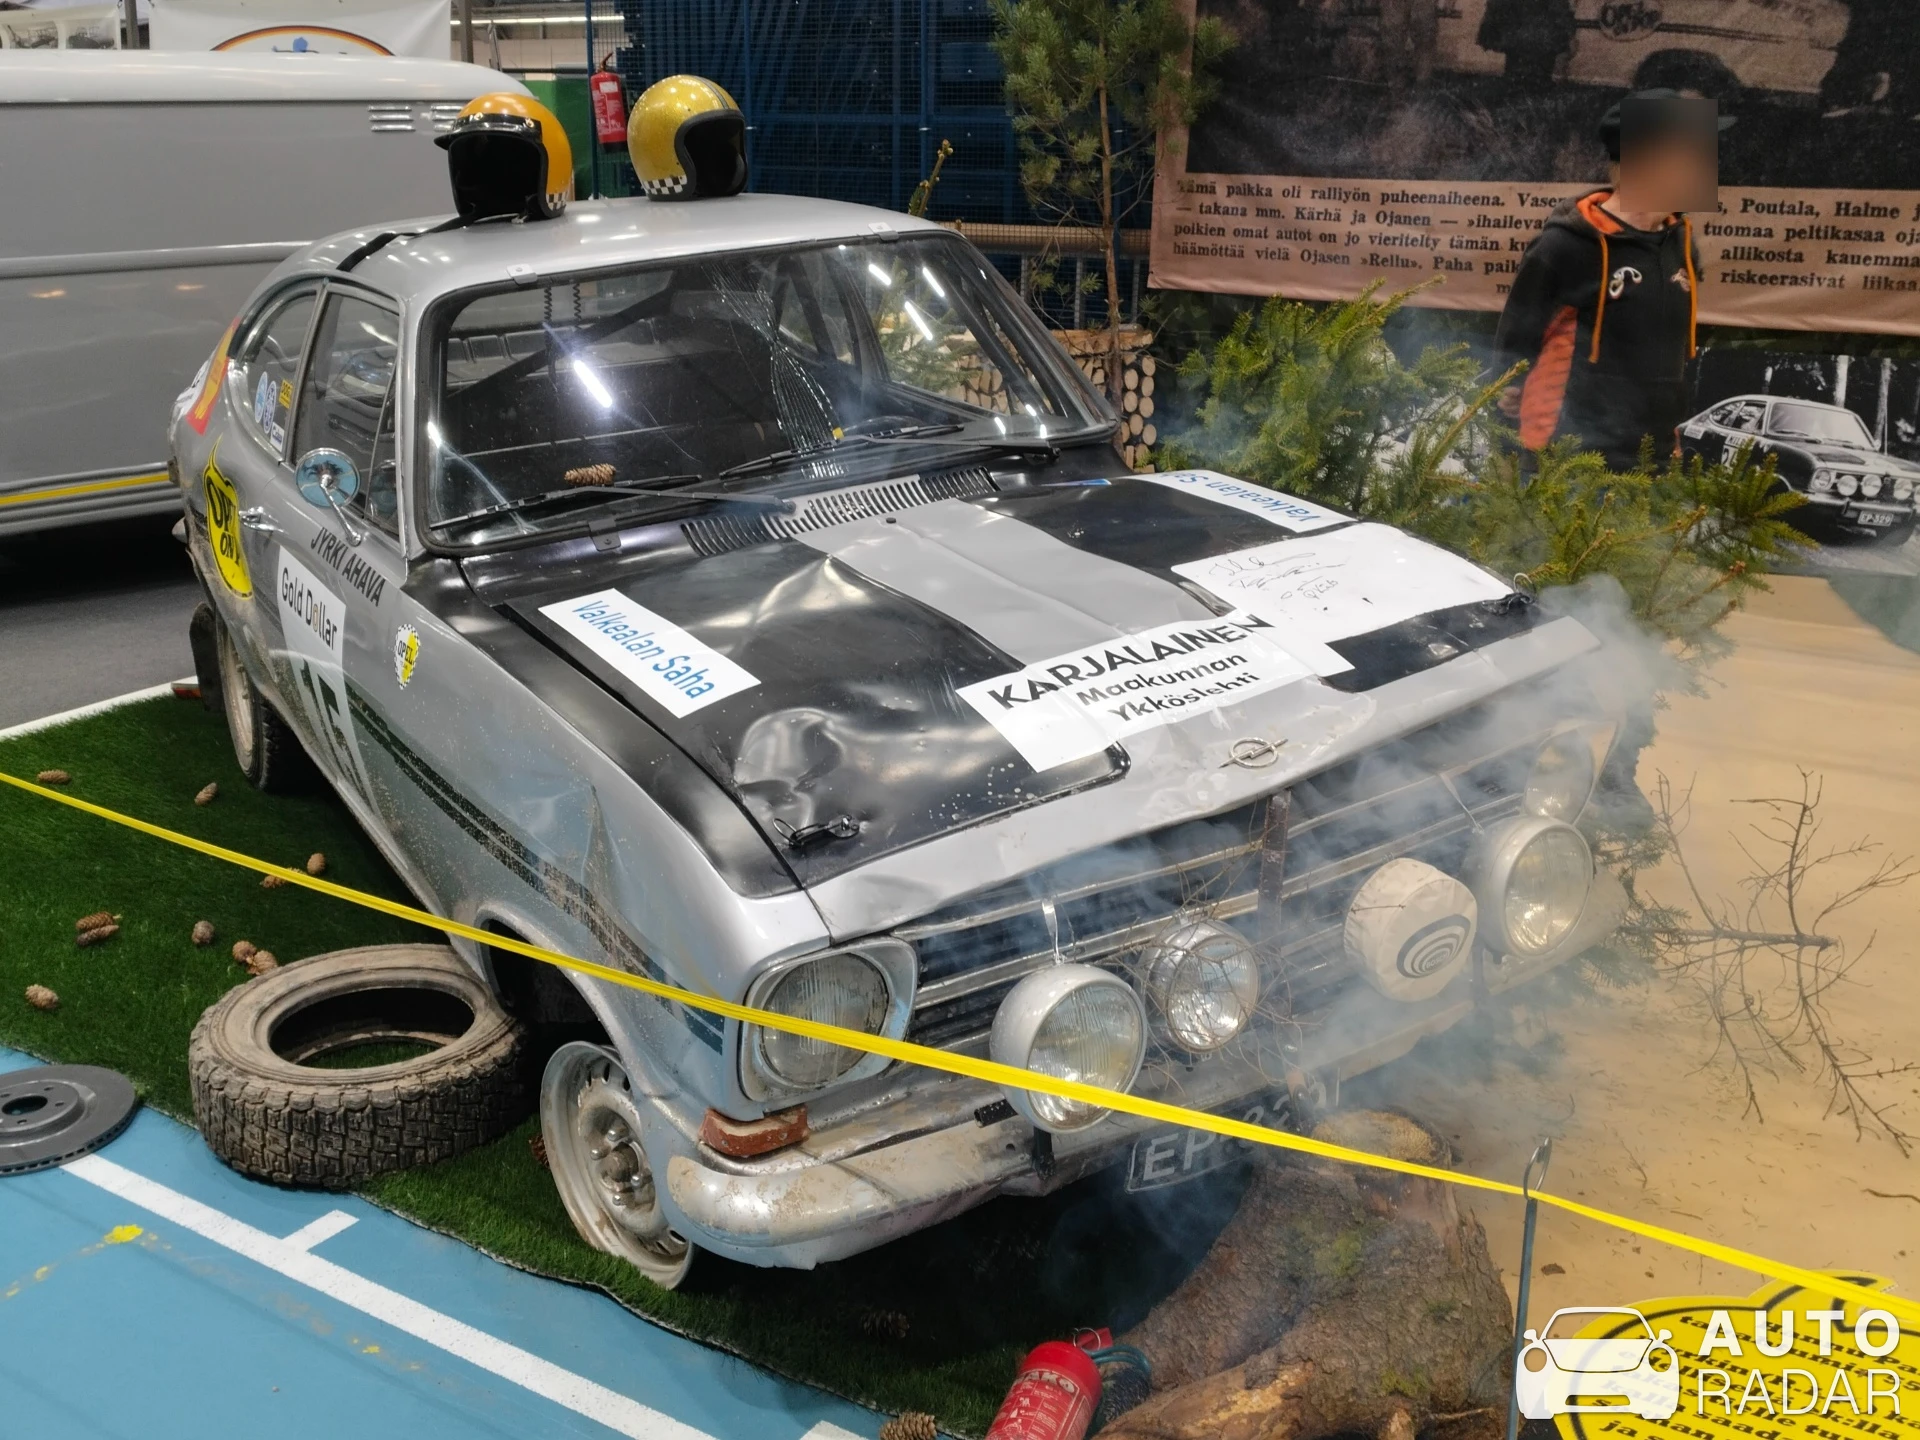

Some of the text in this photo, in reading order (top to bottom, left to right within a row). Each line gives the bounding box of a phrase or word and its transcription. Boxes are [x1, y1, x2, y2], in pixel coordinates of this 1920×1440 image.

[1226, 181, 1273, 198] paikka
[1282, 185, 1301, 198] oli
[1311, 186, 1370, 204] ralliyön
[1380, 189, 1504, 208] puheenaiheena.
[1740, 198, 1821, 219] Poutala,
[1834, 201, 1900, 218] Halme
[1199, 202, 1247, 216] takana
[1255, 207, 1285, 219] mm.
[1294, 206, 1342, 222] Kärhä
[1350, 211, 1366, 226] ja
[1375, 210, 1431, 227] Ojanen
[1173, 222, 1225, 237] poikien
[1233, 225, 1268, 239] omat
[1276, 228, 1312, 242] autot
[1319, 233, 1337, 243] on
[1344, 231, 1360, 246] jo
[1369, 232, 1441, 251] vieritelty
[1449, 236, 1500, 251] tämän
[1704, 221, 1774, 239] tuomaa
[1785, 225, 1885, 243] peltikasaa
[1173, 241, 1245, 259] häämöttää
[1255, 246, 1290, 261] vielä
[1300, 248, 1350, 265] Ojasen
[1432, 255, 1473, 272] Paha
[1721, 246, 1920, 268] allikosta kauemma
[1721, 268, 1845, 289] riskeerasivat
[1205, 481, 1321, 522] Valkealan
[311, 526, 386, 607] JYRKI AHAVA
[281, 566, 338, 651] Gold Dollar
[397, 640, 413, 665] OPEL
[572, 600, 716, 699] Valkealan Saha
[986, 613, 1276, 710] KARJALAINEN
[1076, 653, 1249, 706] Maakunnan
[1107, 671, 1261, 722] Ykköslehti
